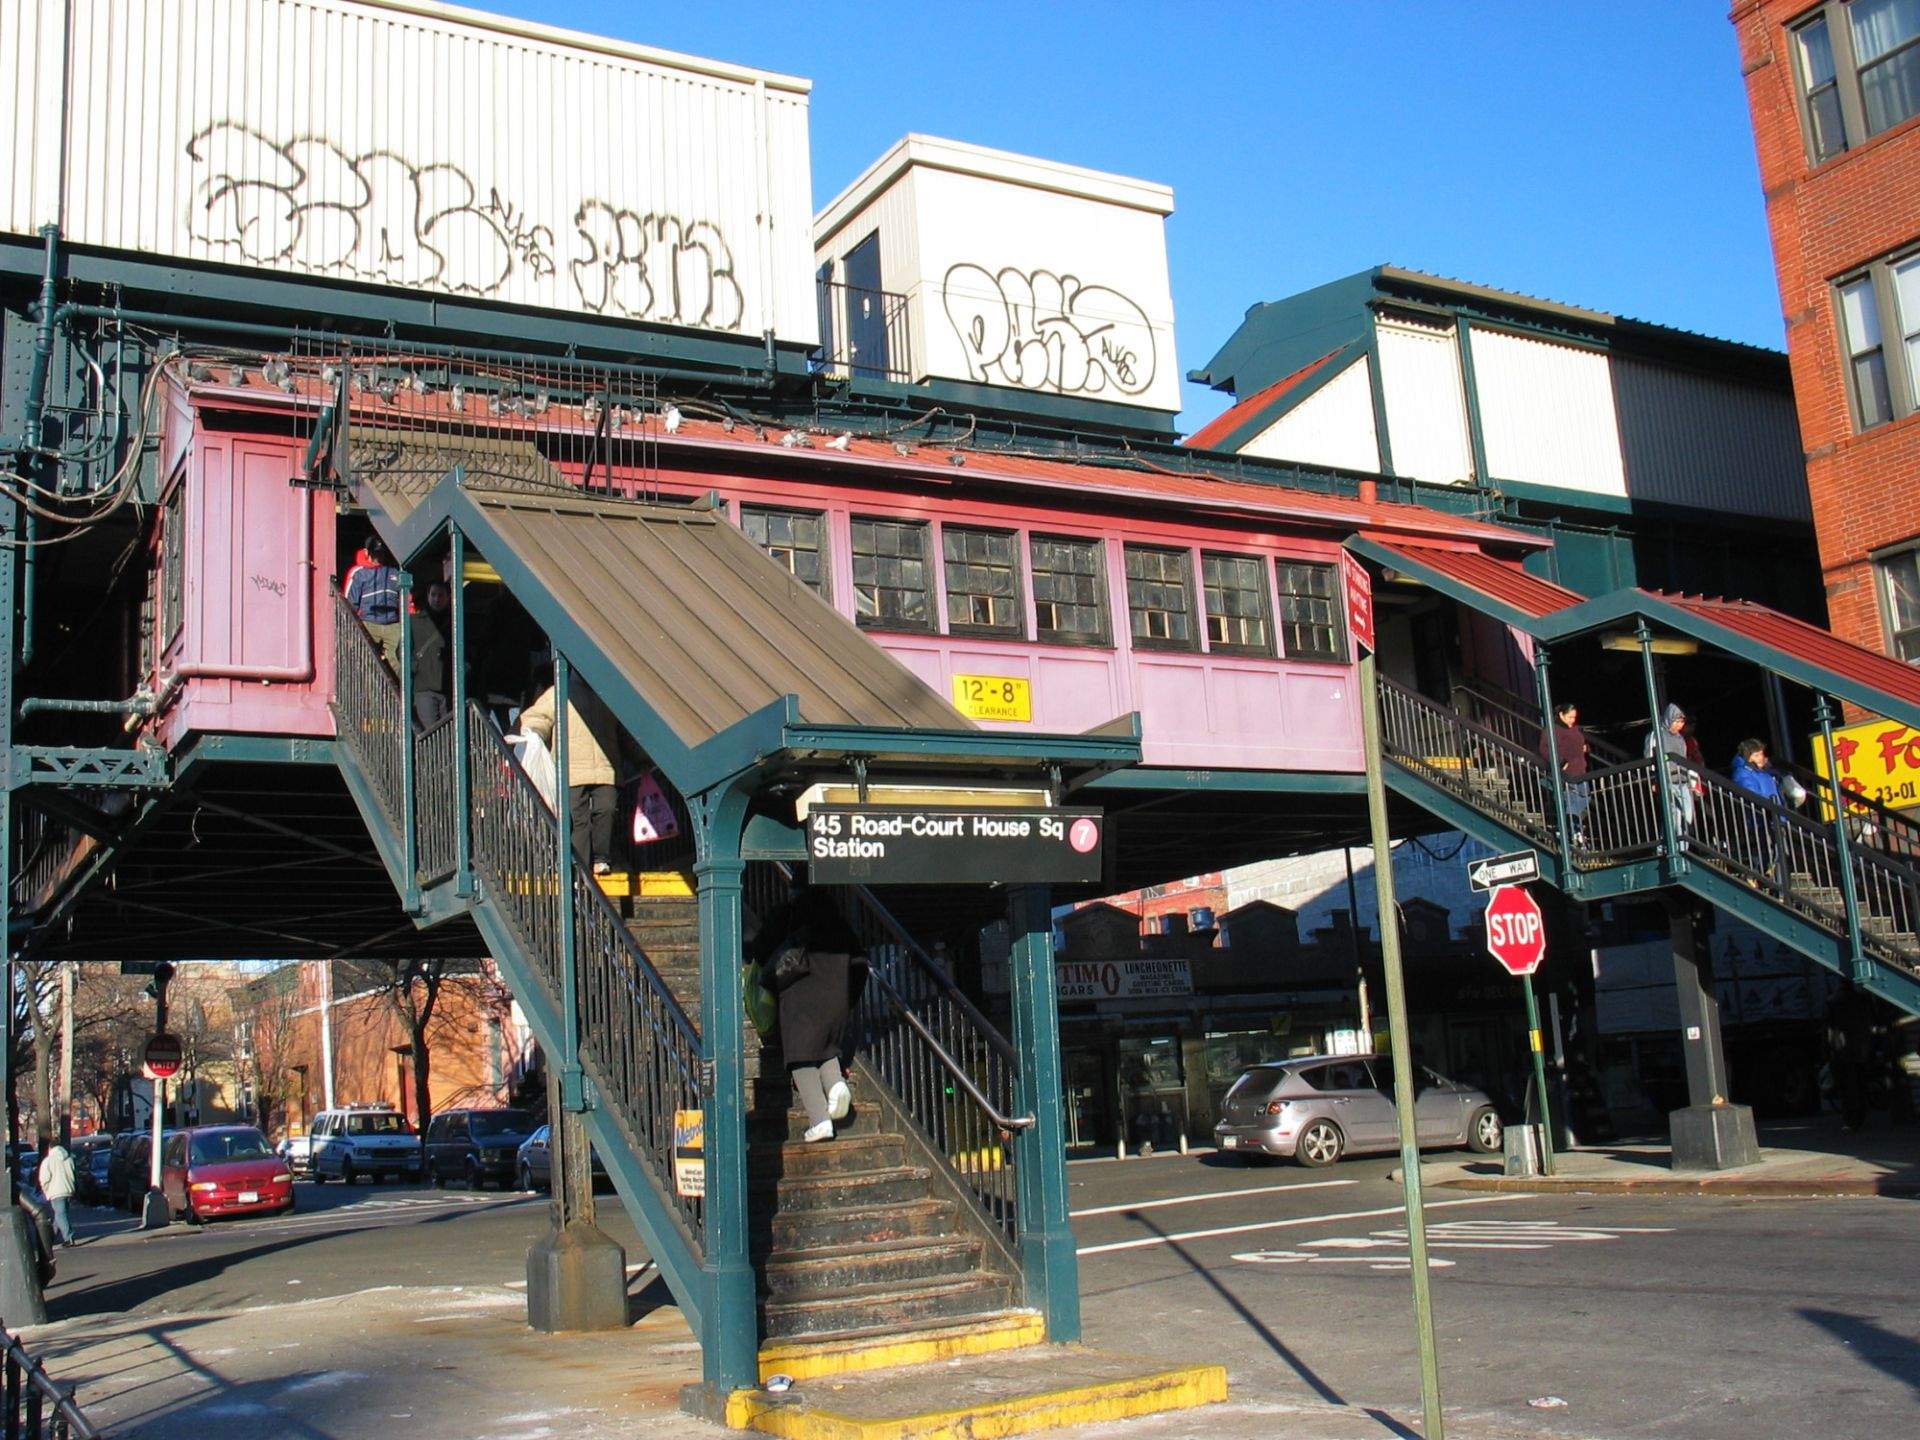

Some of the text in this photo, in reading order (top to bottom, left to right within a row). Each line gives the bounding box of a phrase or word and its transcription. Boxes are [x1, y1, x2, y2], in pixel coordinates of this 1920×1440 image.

[969, 705, 1018, 717] CLEARANCE
[813, 815, 1091, 845] 45 Road-Court House Sq 7
[813, 837, 885, 858] Station
[1479, 860, 1529, 881] ONE WAY
[1491, 912, 1539, 947] STOP
[1058, 963, 1121, 996] TIMO
